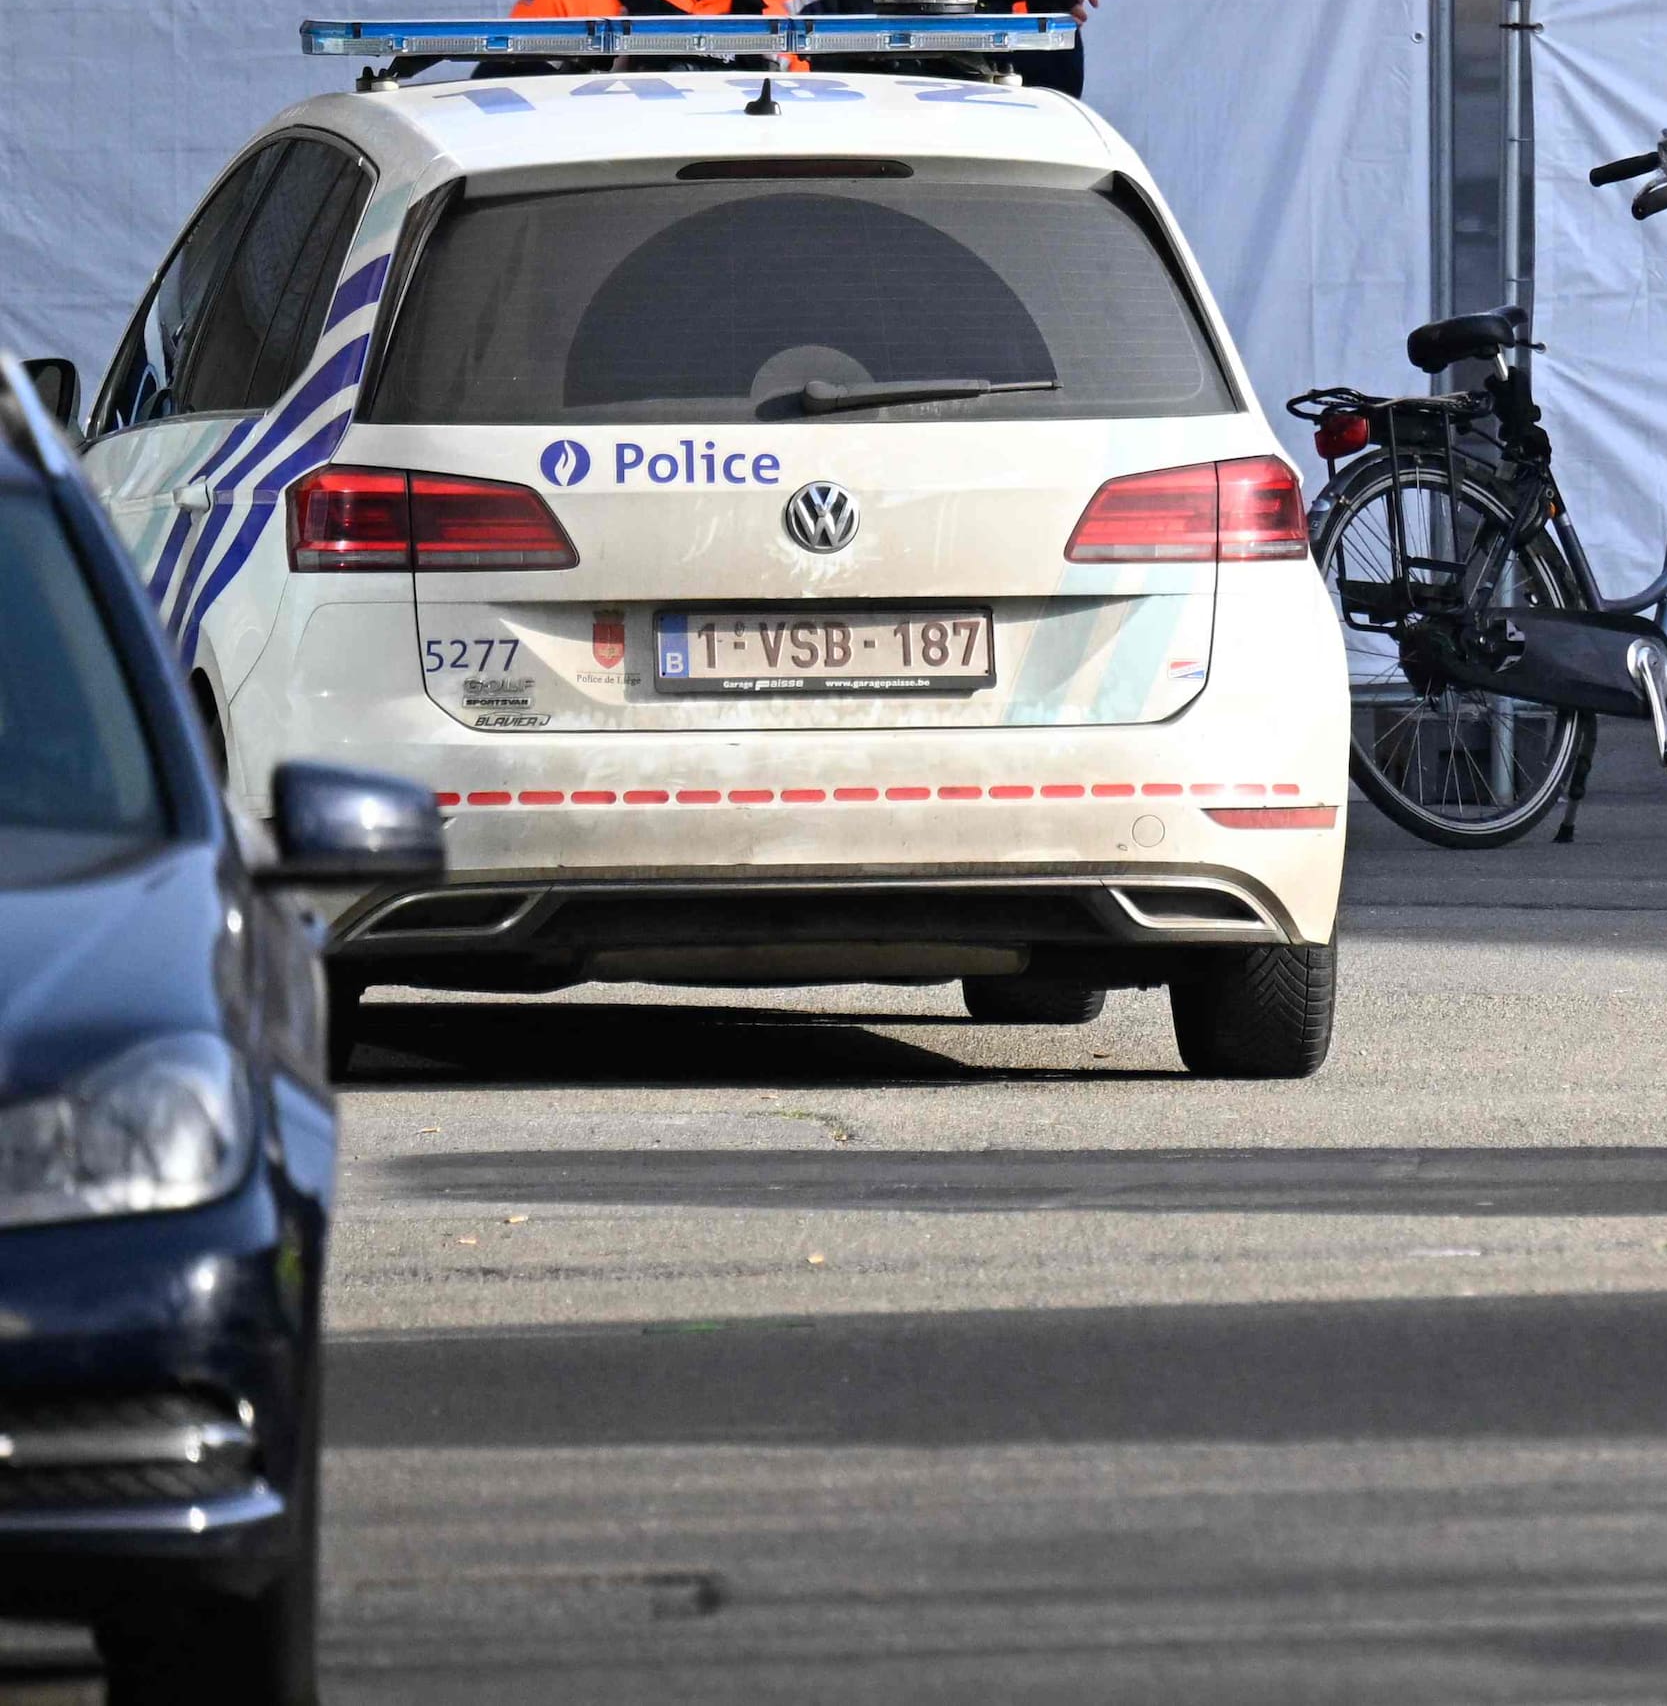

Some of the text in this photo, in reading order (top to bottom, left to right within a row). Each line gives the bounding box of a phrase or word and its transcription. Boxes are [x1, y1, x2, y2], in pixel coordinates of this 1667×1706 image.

[615, 440, 781, 485] Police
[425, 639, 520, 673] 5277
[666, 652, 684, 674] B
[723, 680, 754, 690] Garage
[474, 716, 539, 726] BLAVIER
